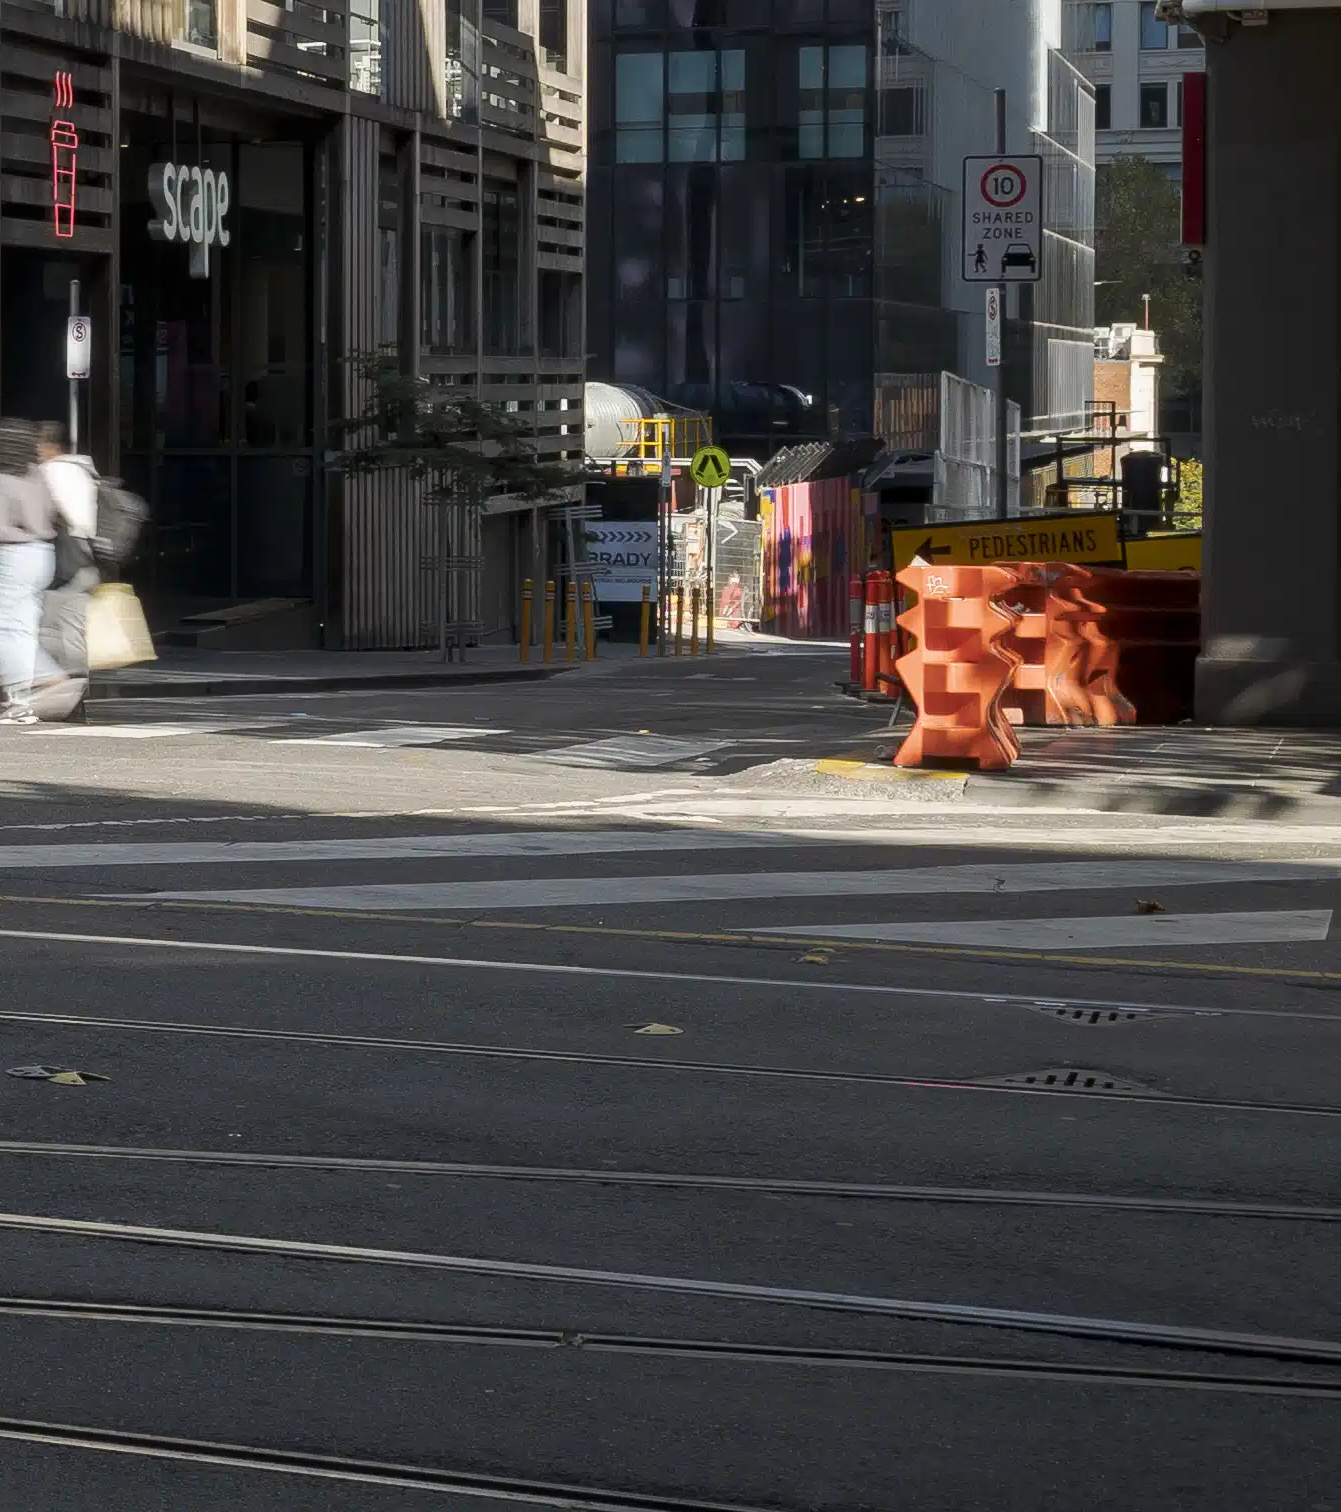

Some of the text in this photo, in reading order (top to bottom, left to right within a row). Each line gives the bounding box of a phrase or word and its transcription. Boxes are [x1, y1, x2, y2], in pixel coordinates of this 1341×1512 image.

[991, 176, 1015, 196] 10
[163, 161, 230, 279] scape
[972, 211, 1034, 224] SHARED
[982, 227, 1024, 240] ZONE
[968, 529, 1097, 560] PEDESTRIANS
